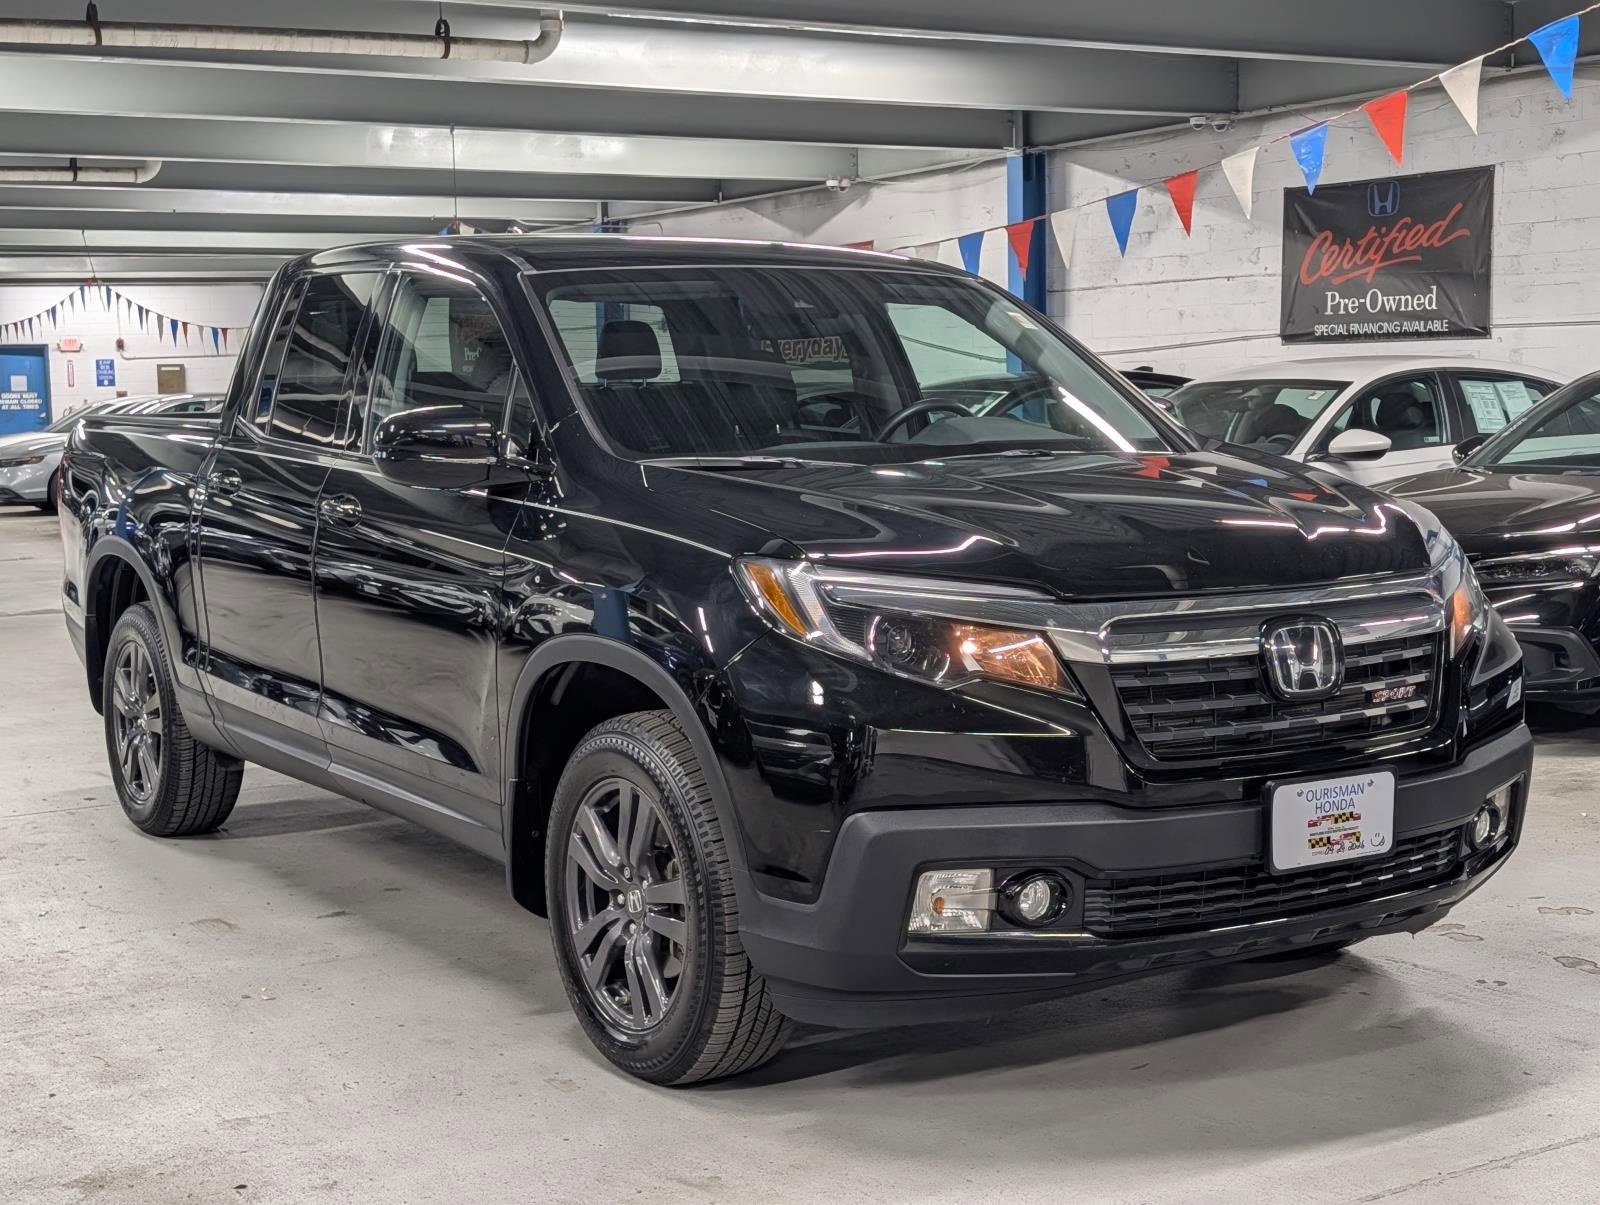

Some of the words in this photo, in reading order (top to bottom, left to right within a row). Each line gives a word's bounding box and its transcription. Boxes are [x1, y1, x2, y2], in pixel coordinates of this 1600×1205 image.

[1300, 202, 1470, 285] Certified
[1324, 286, 1438, 315] Pre-Owned
[1314, 323, 1349, 336] SPECIAL
[1350, 321, 1400, 335] FINANCING
[1402, 319, 1448, 333] AVAILABLE
[1373, 685, 1416, 703] SPORT
[1306, 783, 1365, 802] OURISMAN
[1315, 798, 1355, 814] HONDA
